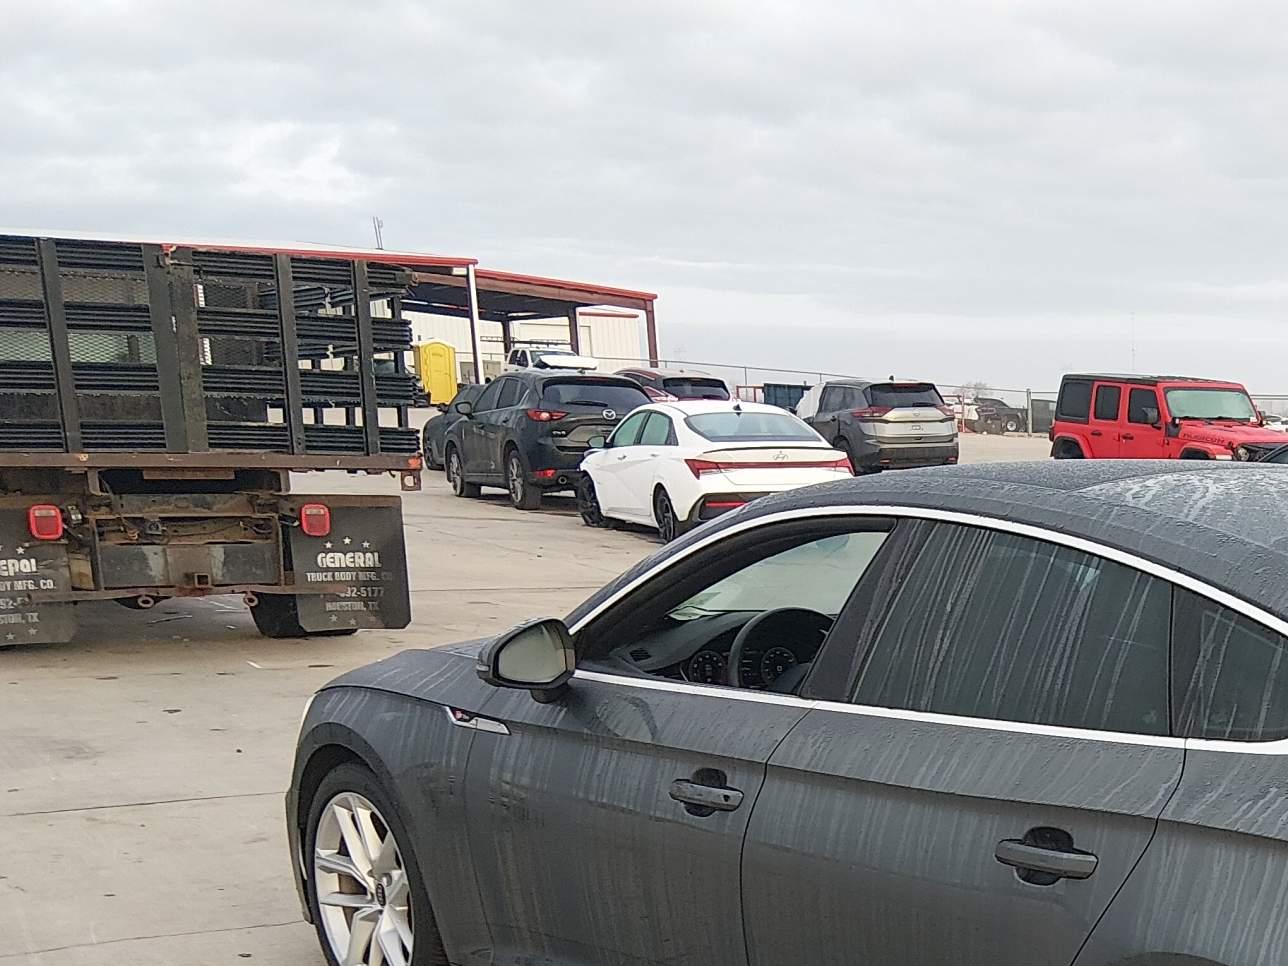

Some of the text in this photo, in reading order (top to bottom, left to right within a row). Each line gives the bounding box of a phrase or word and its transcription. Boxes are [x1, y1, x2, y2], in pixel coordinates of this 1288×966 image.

[317, 552, 381, 568] GENERAL
[306, 572, 334, 582] TRUCK
[40, 579, 56, 590] CO.
